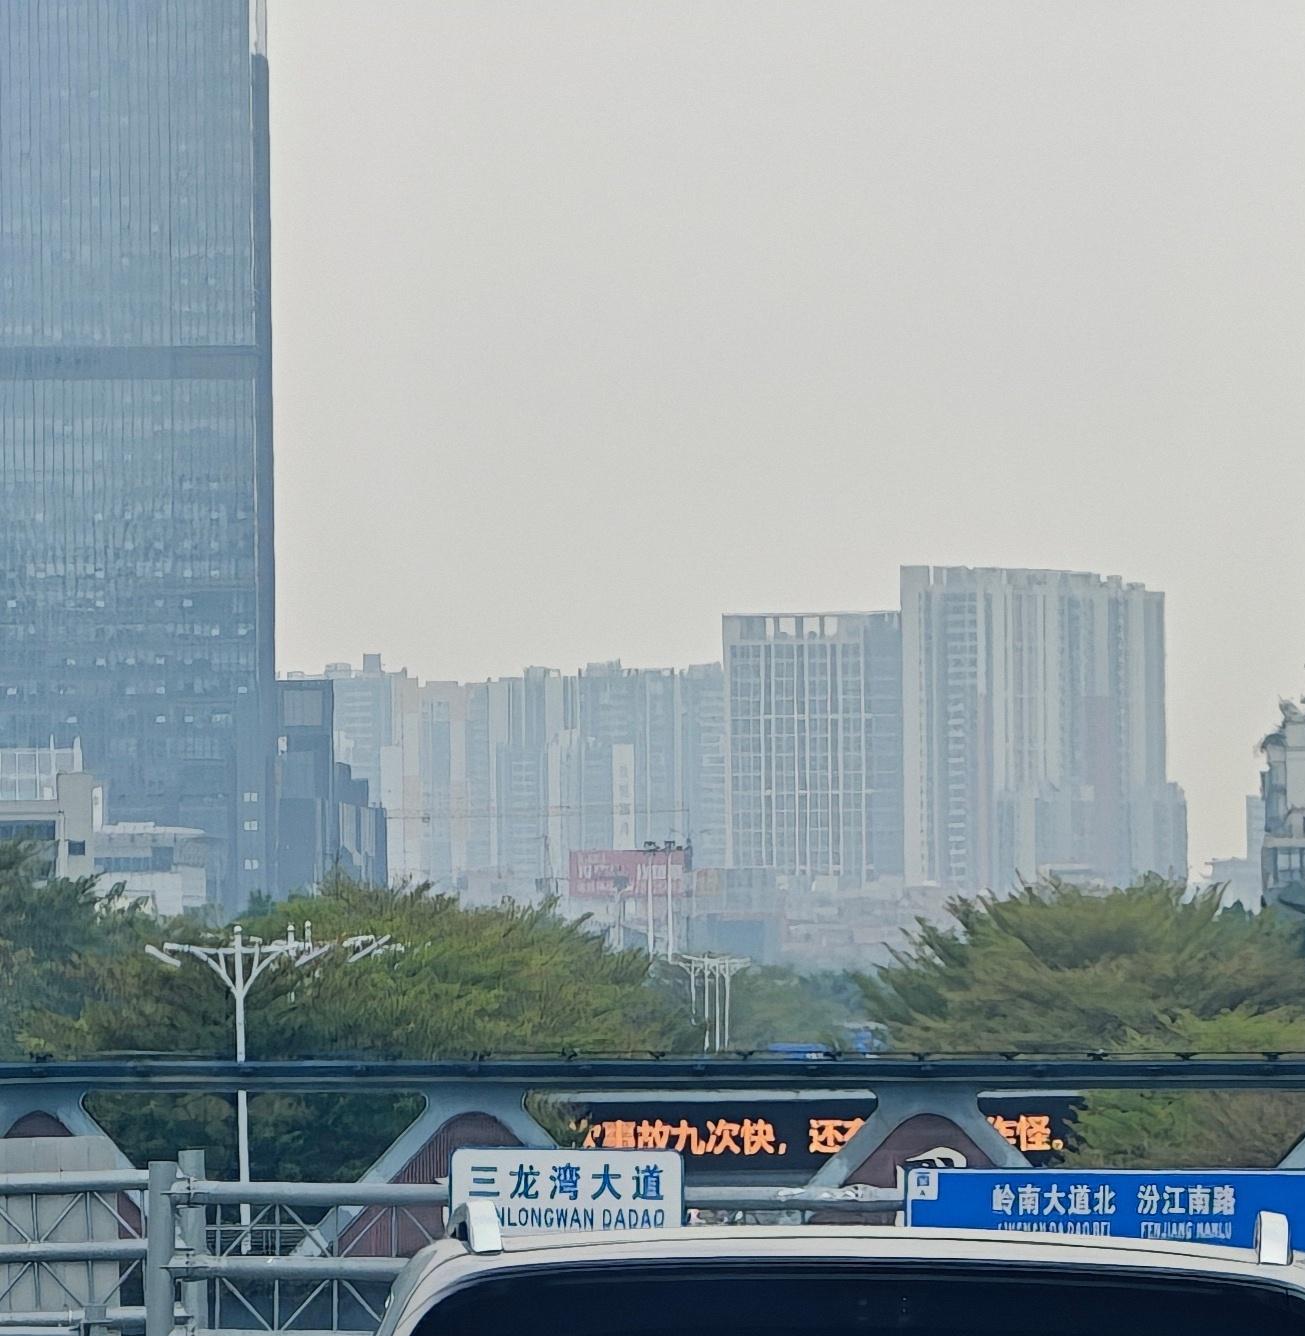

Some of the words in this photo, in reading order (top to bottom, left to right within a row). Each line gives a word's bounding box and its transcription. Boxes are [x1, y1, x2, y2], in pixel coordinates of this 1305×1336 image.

[469, 1162, 664, 1201] 三龙湾大道
[992, 1183, 1117, 1216] 岭南大道北
[1137, 1184, 1236, 1216] 汾江南路
